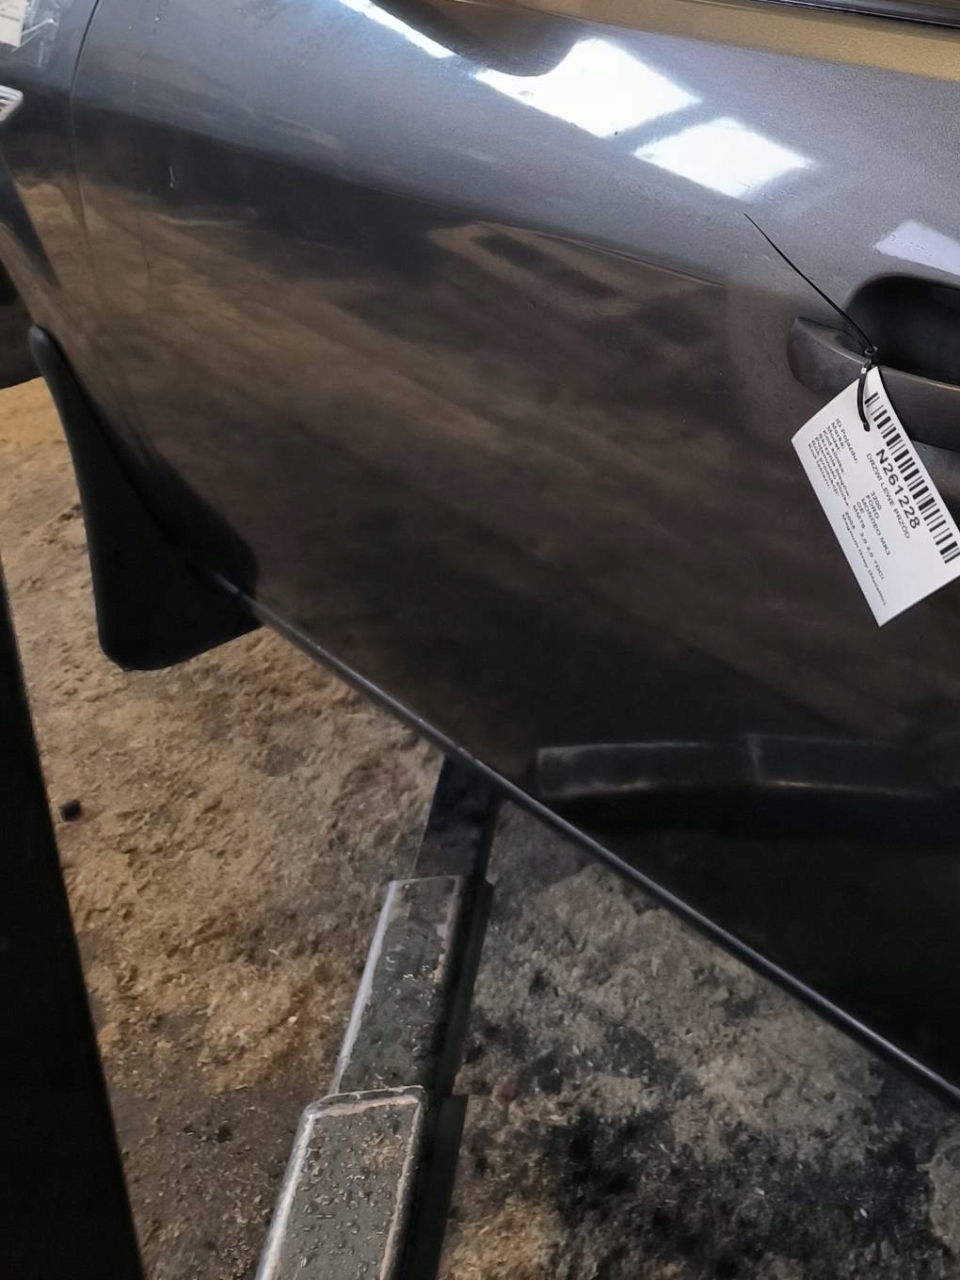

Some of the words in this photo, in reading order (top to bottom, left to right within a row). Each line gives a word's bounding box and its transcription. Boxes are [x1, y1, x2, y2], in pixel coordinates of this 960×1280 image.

[865, 452, 883, 481] DRZWI
[879, 481, 895, 507] LEWE
[874, 447, 922, 530] N261228
[859, 497, 882, 537] MONDEO
[864, 493, 881, 520] FORD
